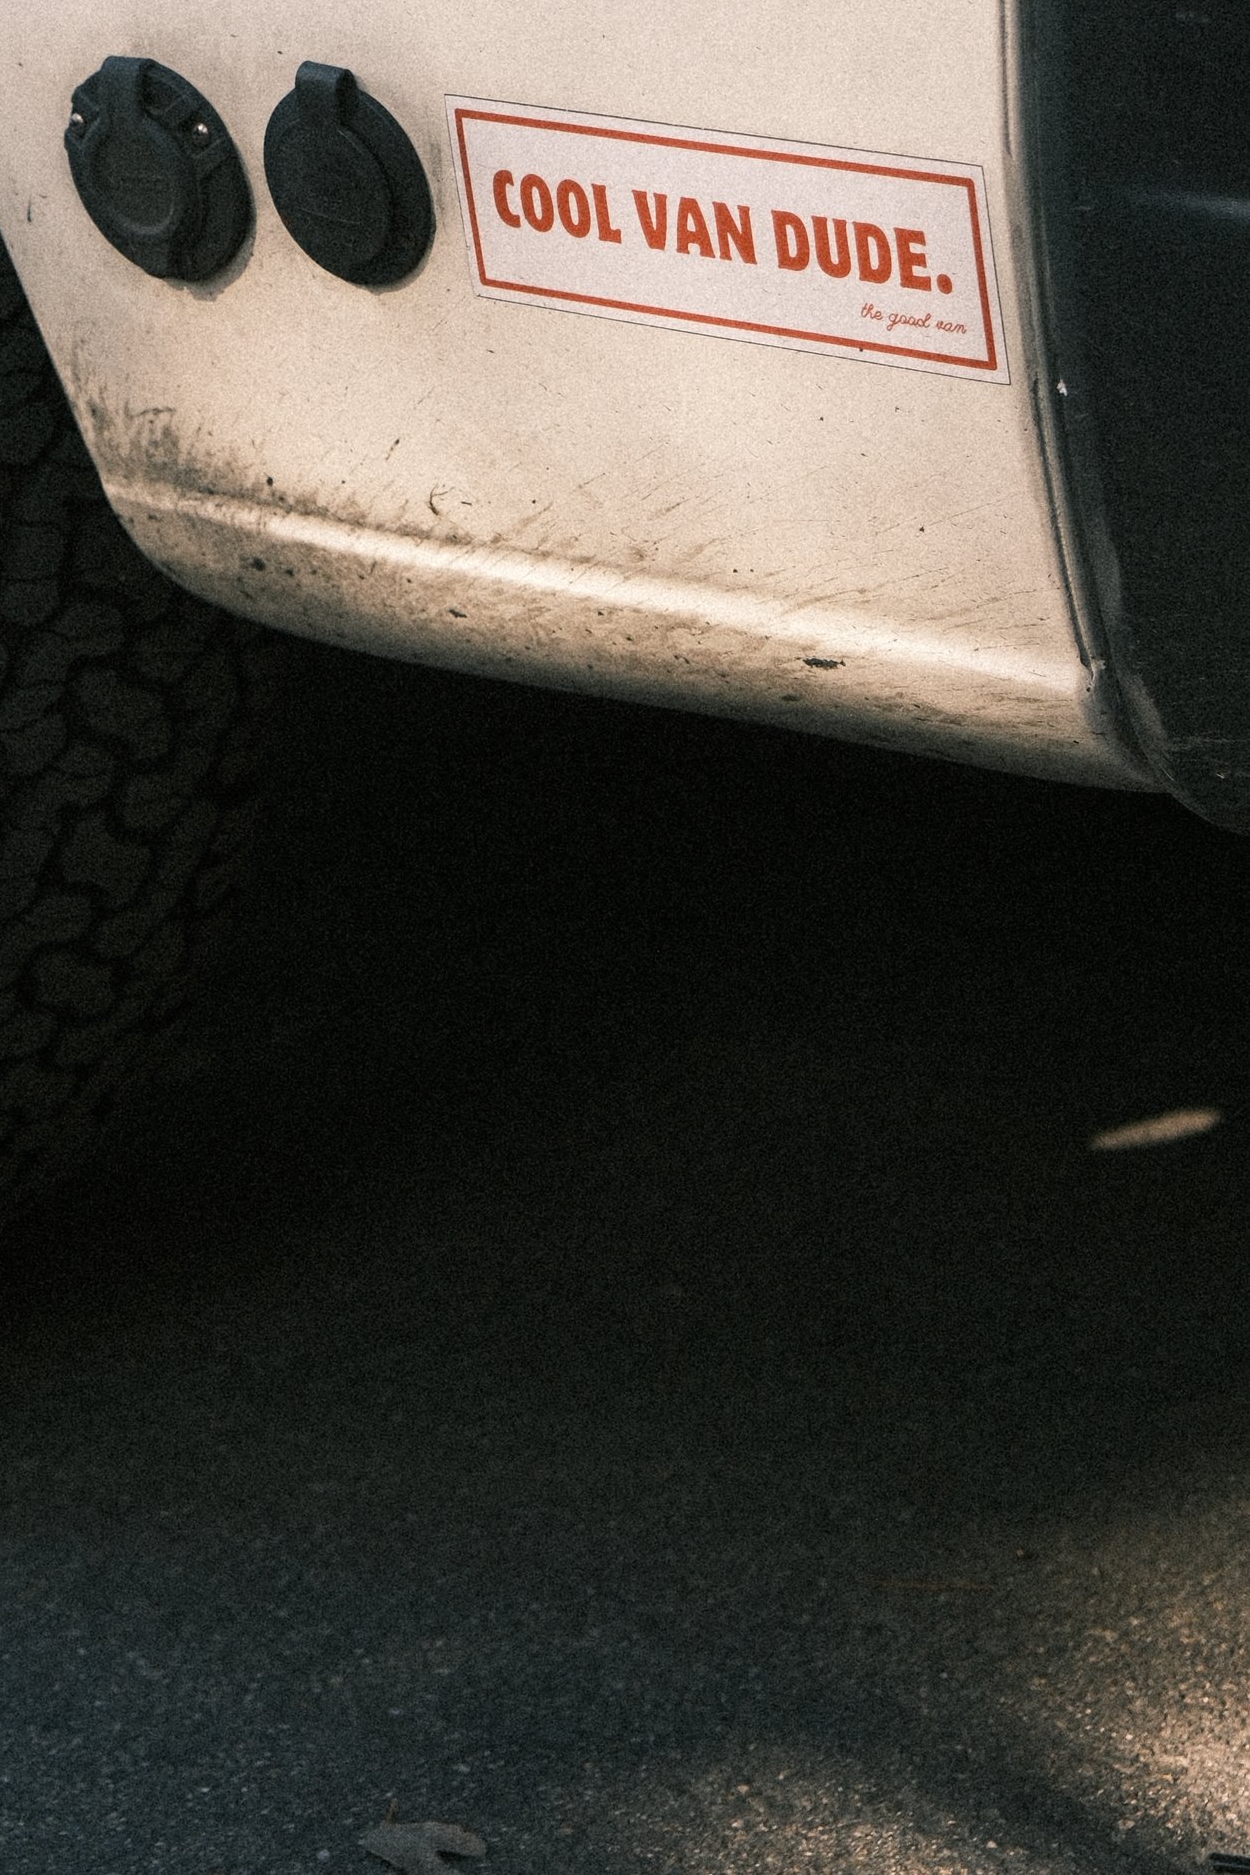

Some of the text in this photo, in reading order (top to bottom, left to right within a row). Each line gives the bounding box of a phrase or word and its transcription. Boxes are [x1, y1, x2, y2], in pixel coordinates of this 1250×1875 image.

[492, 169, 952, 295] COOL VAN DUDE.
[861, 303, 967, 334] the good van
